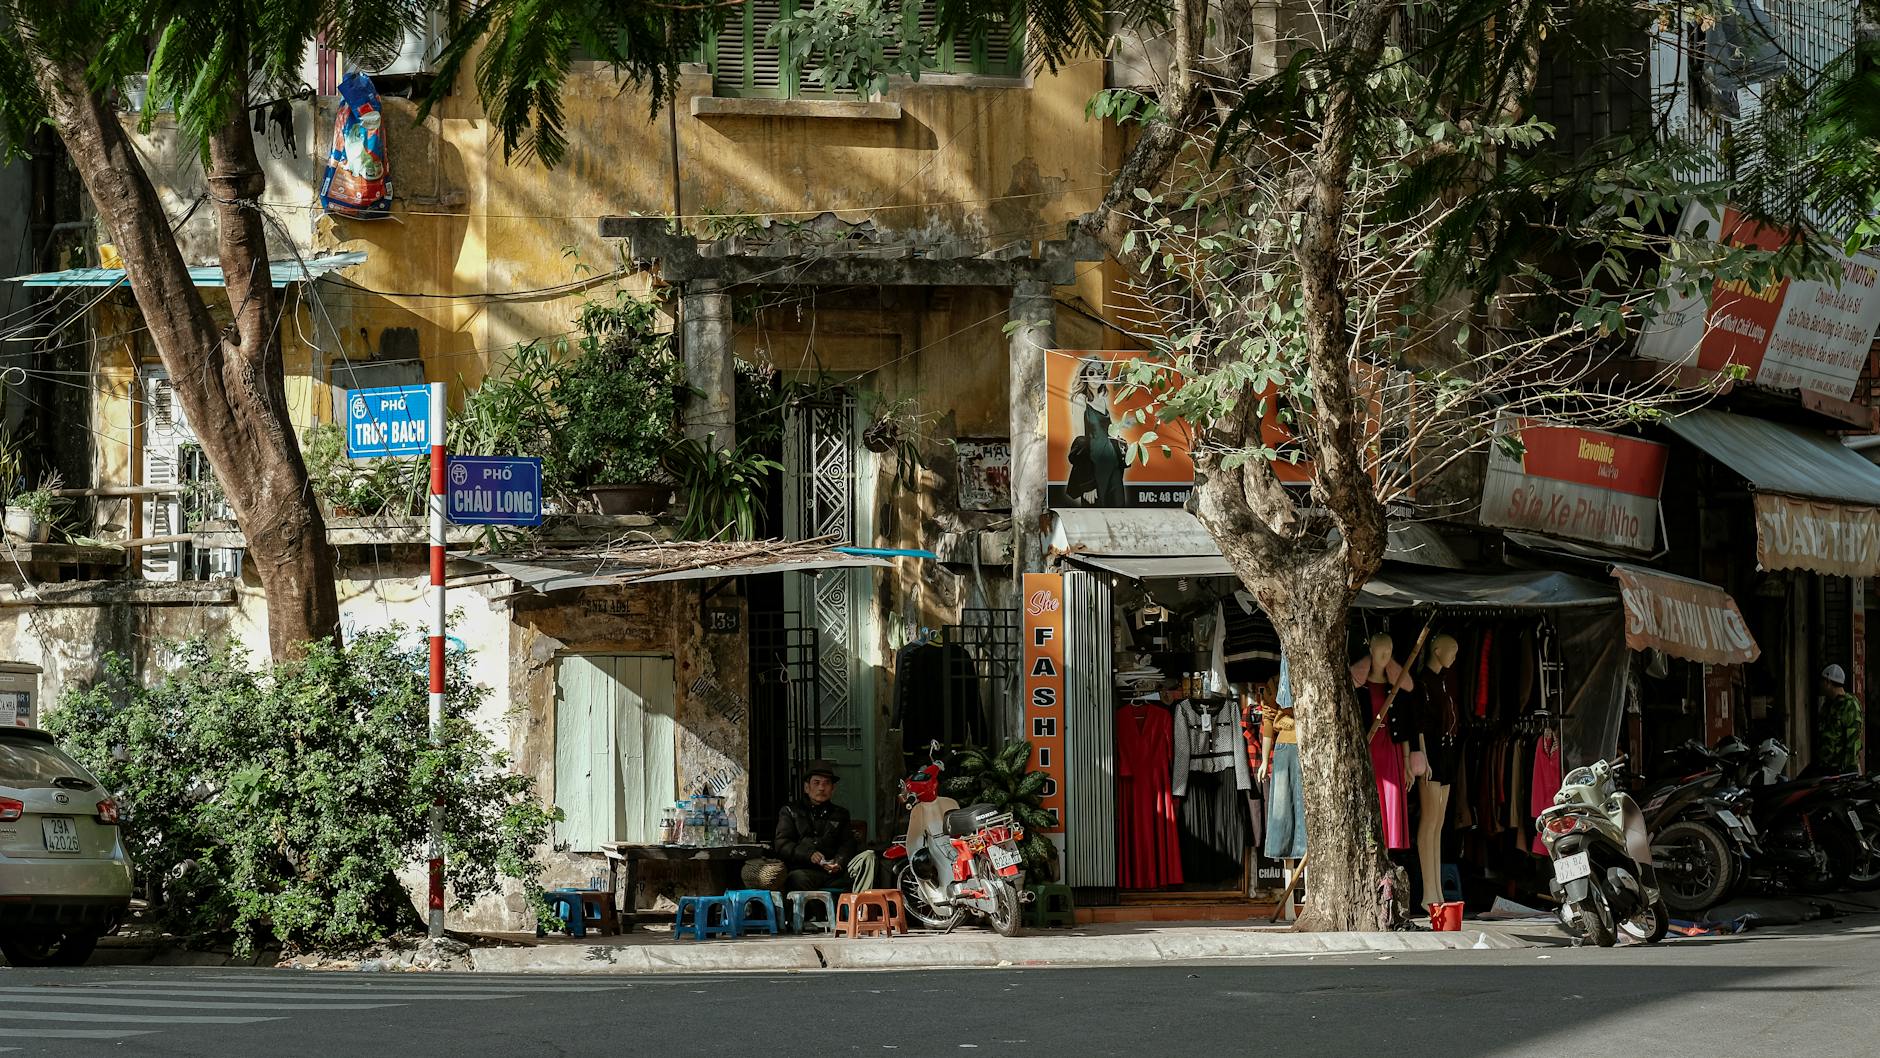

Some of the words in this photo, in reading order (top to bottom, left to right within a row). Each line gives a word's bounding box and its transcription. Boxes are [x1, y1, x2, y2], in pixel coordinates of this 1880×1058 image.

[381, 394, 408, 411] PHỐ
[355, 418, 388, 446] TRÚC
[391, 420, 425, 447] BẠCH
[1578, 437, 1615, 464] Havoline
[483, 464, 513, 481] PHỐ
[454, 485, 492, 513] CHÂU
[496, 490, 533, 513] LONG
[1138, 491, 1158, 503] Đ/C:
[1159, 491, 1171, 503] 48
[1172, 489, 1192, 503] CHÂ
[1545, 493, 1571, 528] Xe
[1027, 590, 1059, 616] She
[710, 612, 737, 630] 139
[1031, 626, 1059, 828] FASHIO
[975, 810, 999, 820] HONDA
[51, 819, 70, 834] 29A
[48, 835, 79, 851] 420.26
[1258, 866, 1281, 879] CHÂU
